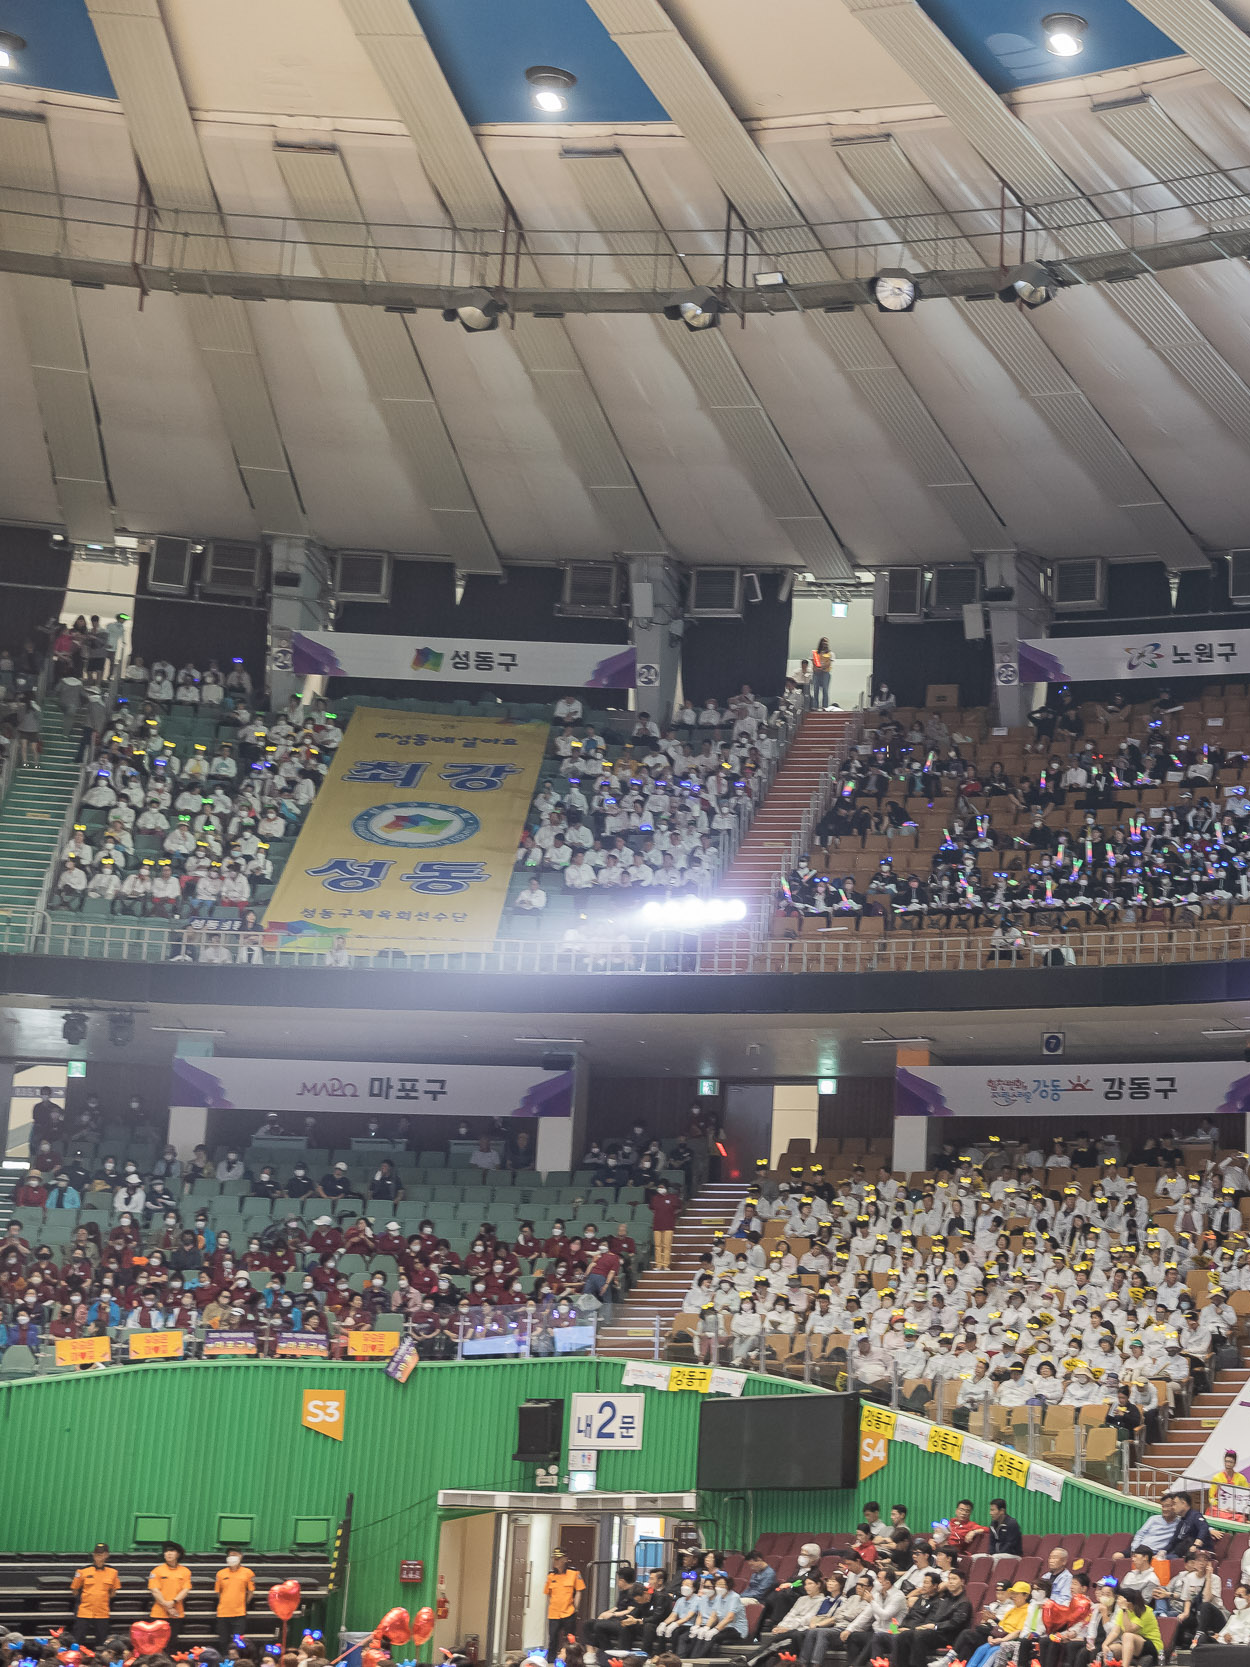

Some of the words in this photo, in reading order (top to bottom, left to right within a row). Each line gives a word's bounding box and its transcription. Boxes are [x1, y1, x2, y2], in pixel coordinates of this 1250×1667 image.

[450, 650, 518, 672] 성동구
[1172, 642, 1237, 664] 노원구
[639, 666, 658, 683] 24
[998, 667, 1017, 682] 25
[341, 761, 523, 791] 최강
[305, 858, 492, 895] 성동
[300, 907, 469, 923] 성동구체육회선수단
[369, 1077, 448, 1101] 마포구
[1032, 1079, 1062, 1102] 강동
[1102, 1076, 1178, 1101] 강동구
[673, 1369, 707, 1387] 강동구
[306, 1400, 340, 1423] S3
[863, 1408, 894, 1433] 강동구
[861, 1438, 886, 1463] S4
[928, 1430, 963, 1457] 강동구
[996, 1453, 1026, 1482] 강동구
